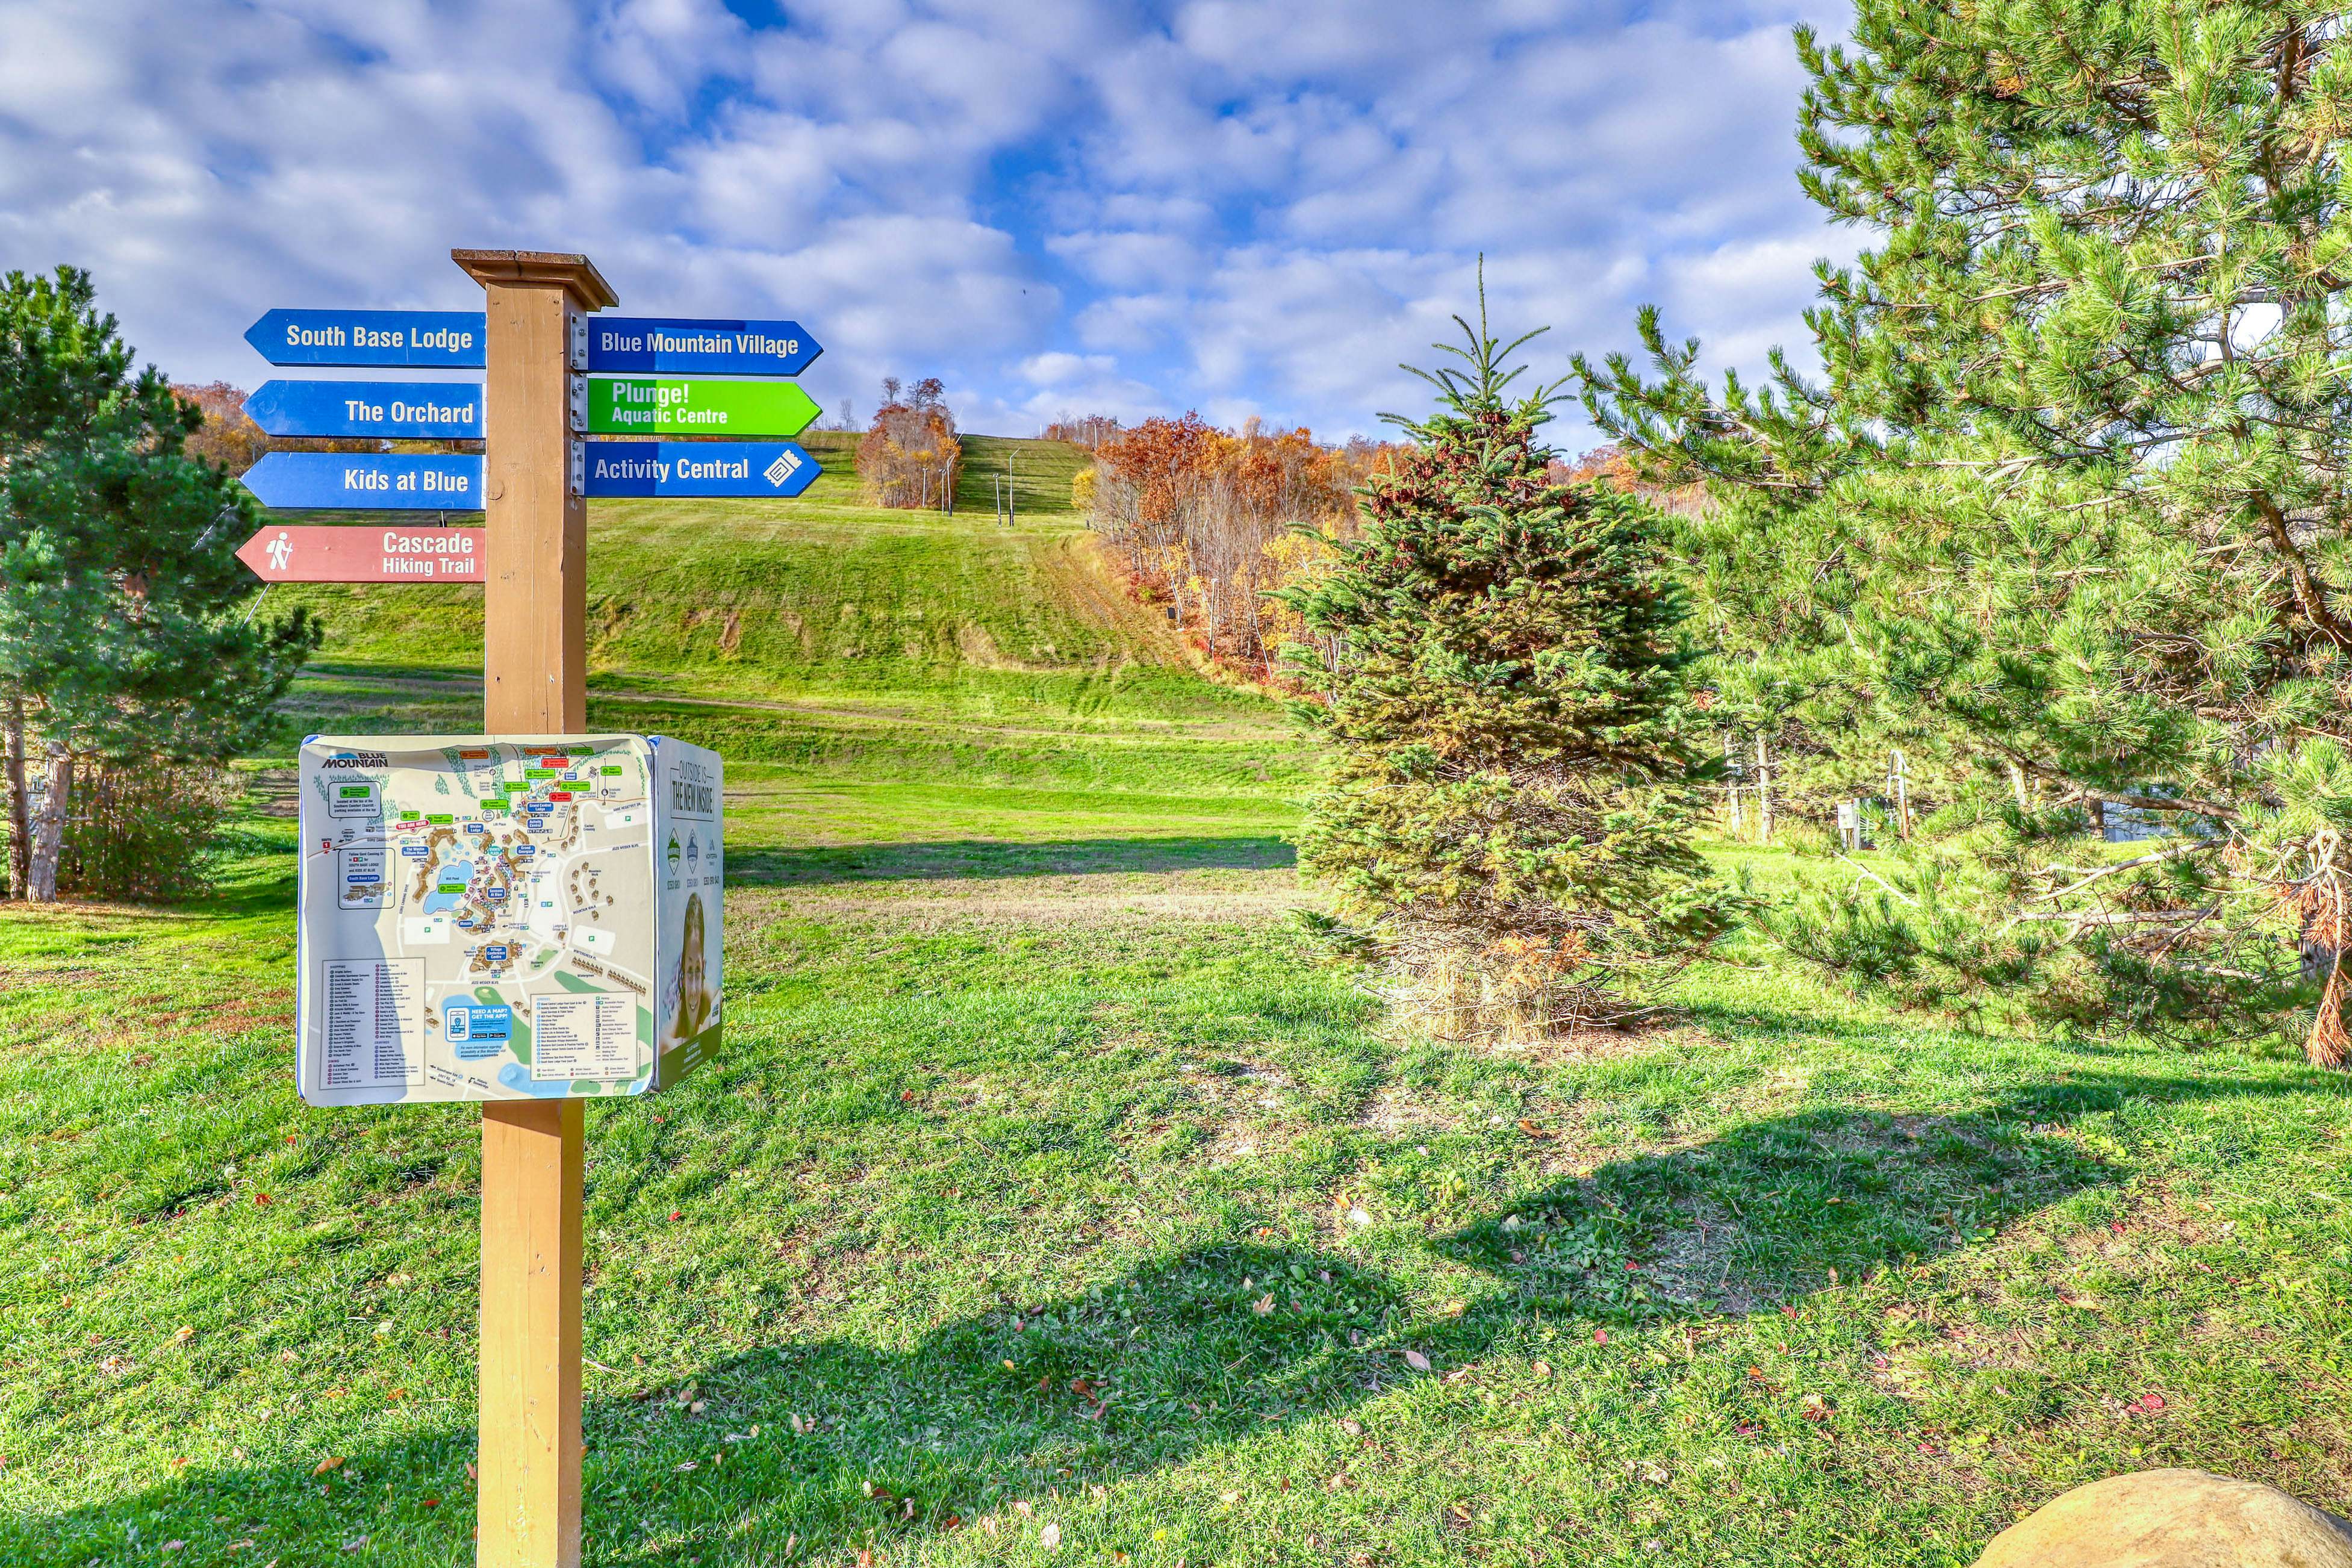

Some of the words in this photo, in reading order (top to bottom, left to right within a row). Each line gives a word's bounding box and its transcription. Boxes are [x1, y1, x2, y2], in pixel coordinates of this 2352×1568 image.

[287, 325, 346, 347] South
[353, 326, 403, 348] Base
[411, 328, 473, 353] Lodge
[602, 332, 642, 352] Blue
[647, 333, 732, 354] Mountain
[736, 334, 798, 358] Village
[612, 382, 689, 407] Plunge!
[344, 400, 384, 422] The
[391, 401, 474, 423] Orchard
[612, 406, 671, 426] Aquatic
[676, 407, 728, 424] Centre
[344, 468, 389, 491] Kids
[396, 471, 416, 491] at
[423, 471, 468, 492] Blue
[594, 458, 670, 484] Activity
[676, 459, 748, 479] Central
[382, 531, 473, 554] Cascade
[382, 557, 434, 577] Hiking
[439, 557, 474, 574] Trail
[322, 759, 388, 768] MOUNTAIN
[679, 760, 700, 783] OUTSIDE
[702, 766, 707, 784] IS
[672, 780, 683, 810] THE
[684, 782, 695, 812] NEW
[697, 785, 712, 814] INSIDE
